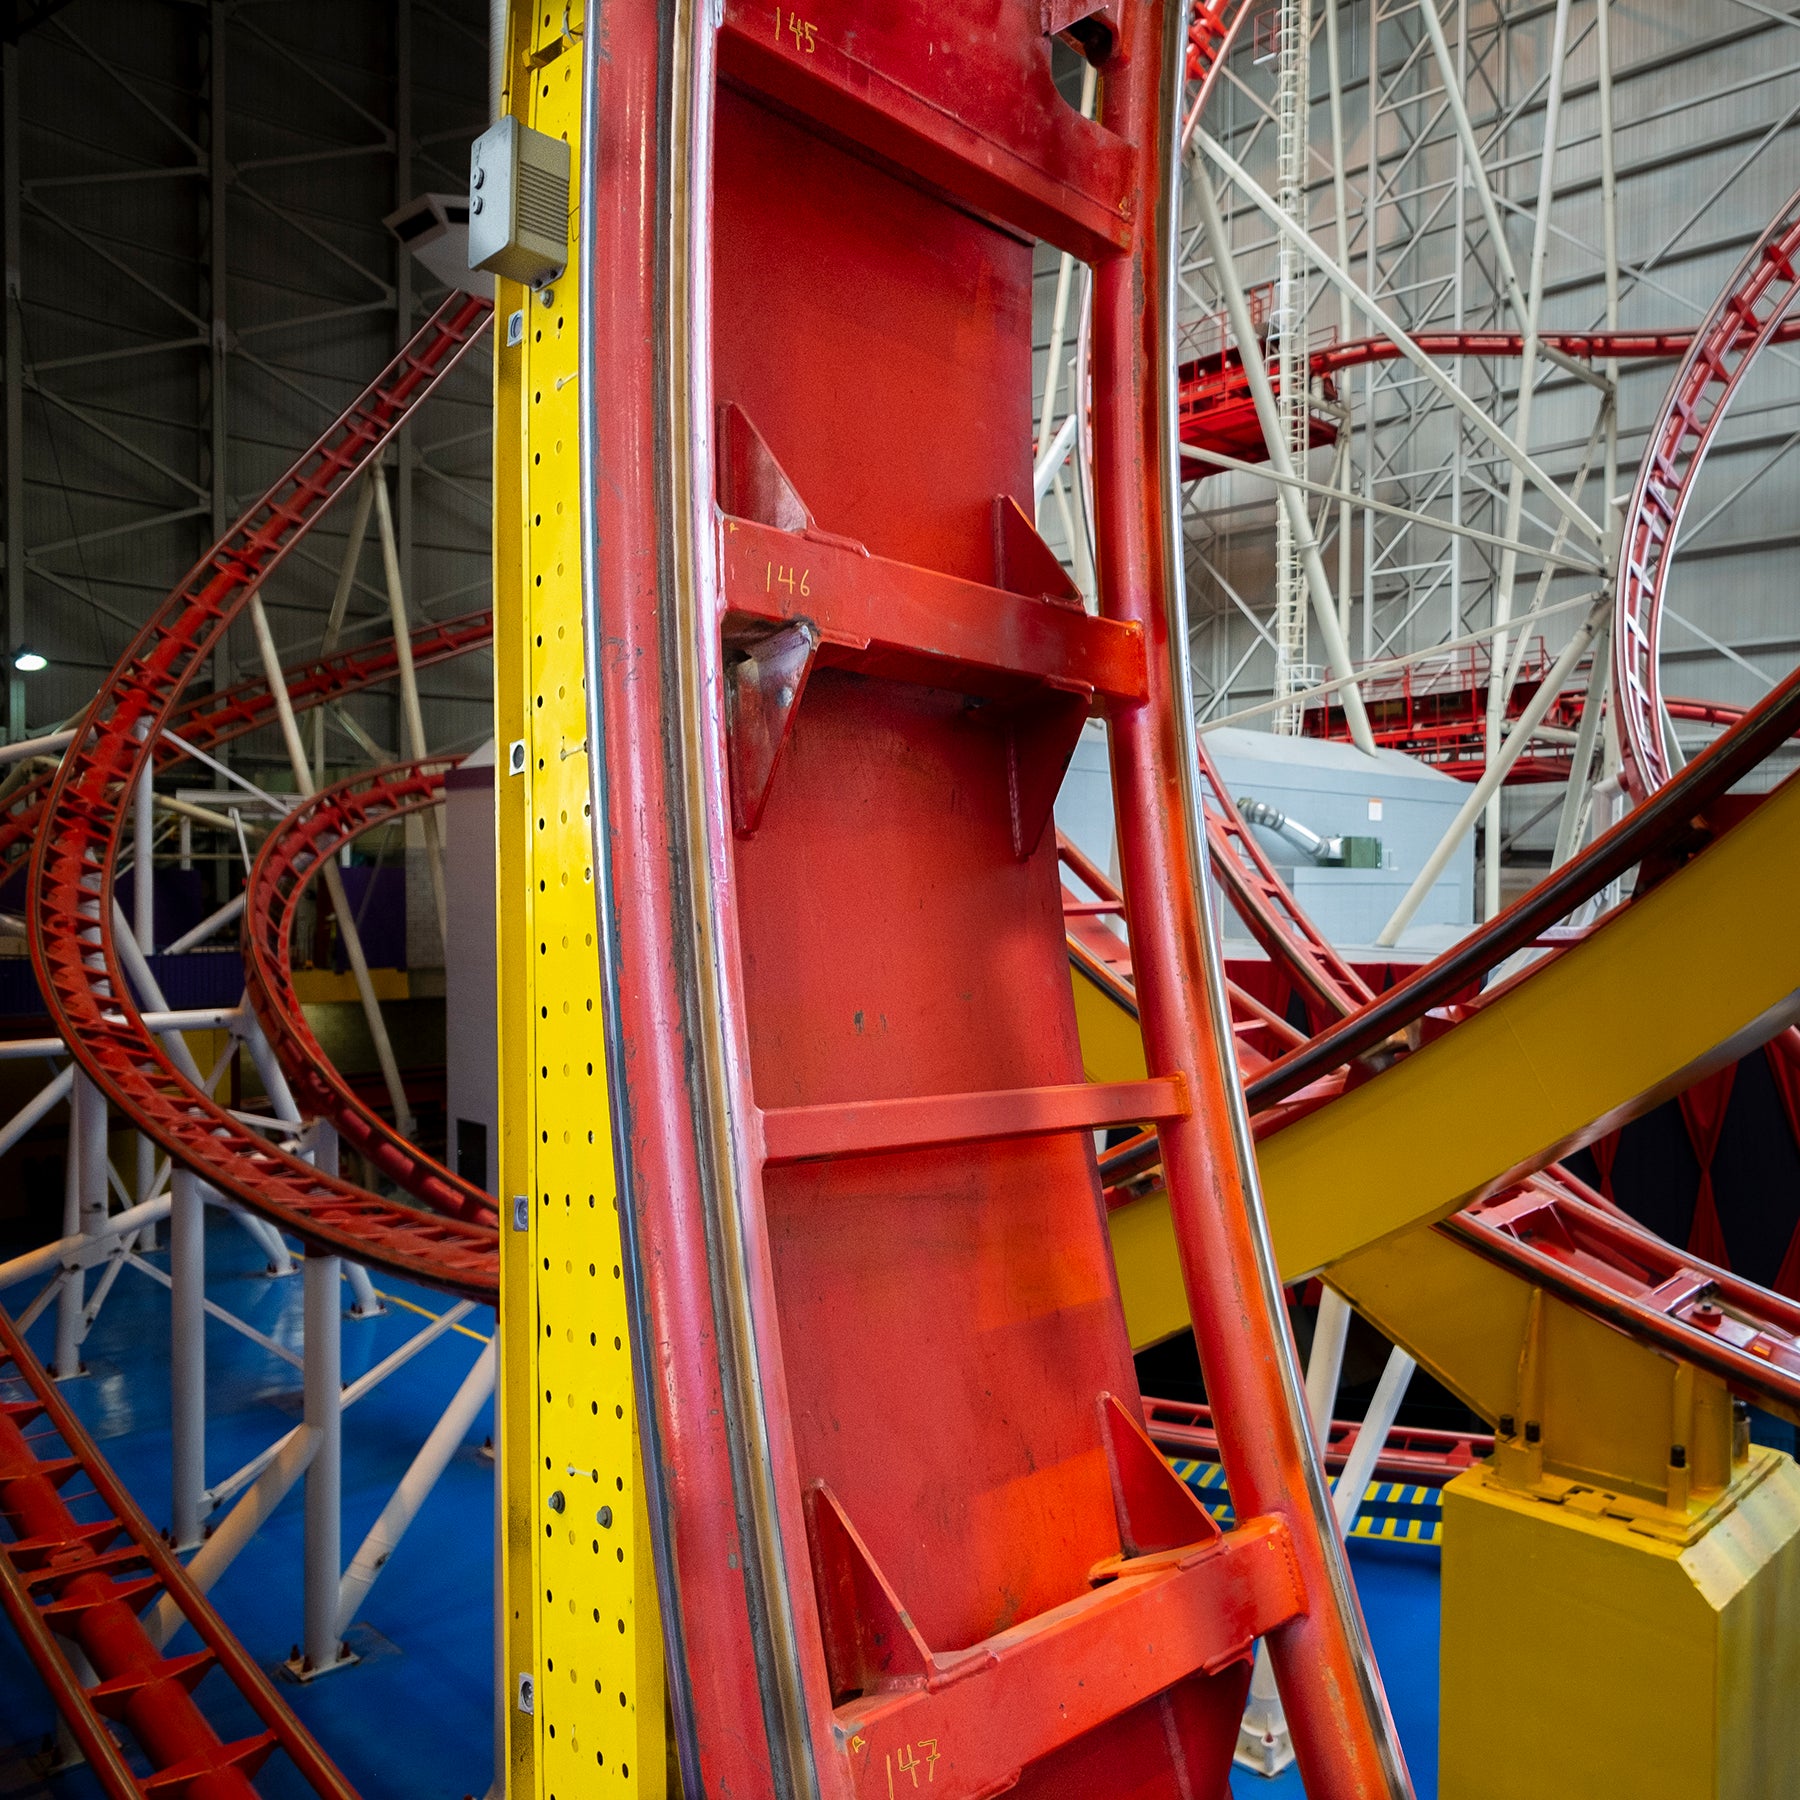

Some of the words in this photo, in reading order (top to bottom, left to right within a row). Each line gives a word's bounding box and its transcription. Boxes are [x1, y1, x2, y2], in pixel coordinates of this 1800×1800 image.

[774, 6, 818, 54] 145
[766, 561, 811, 597] 146
[885, 1739, 941, 1800] 147
